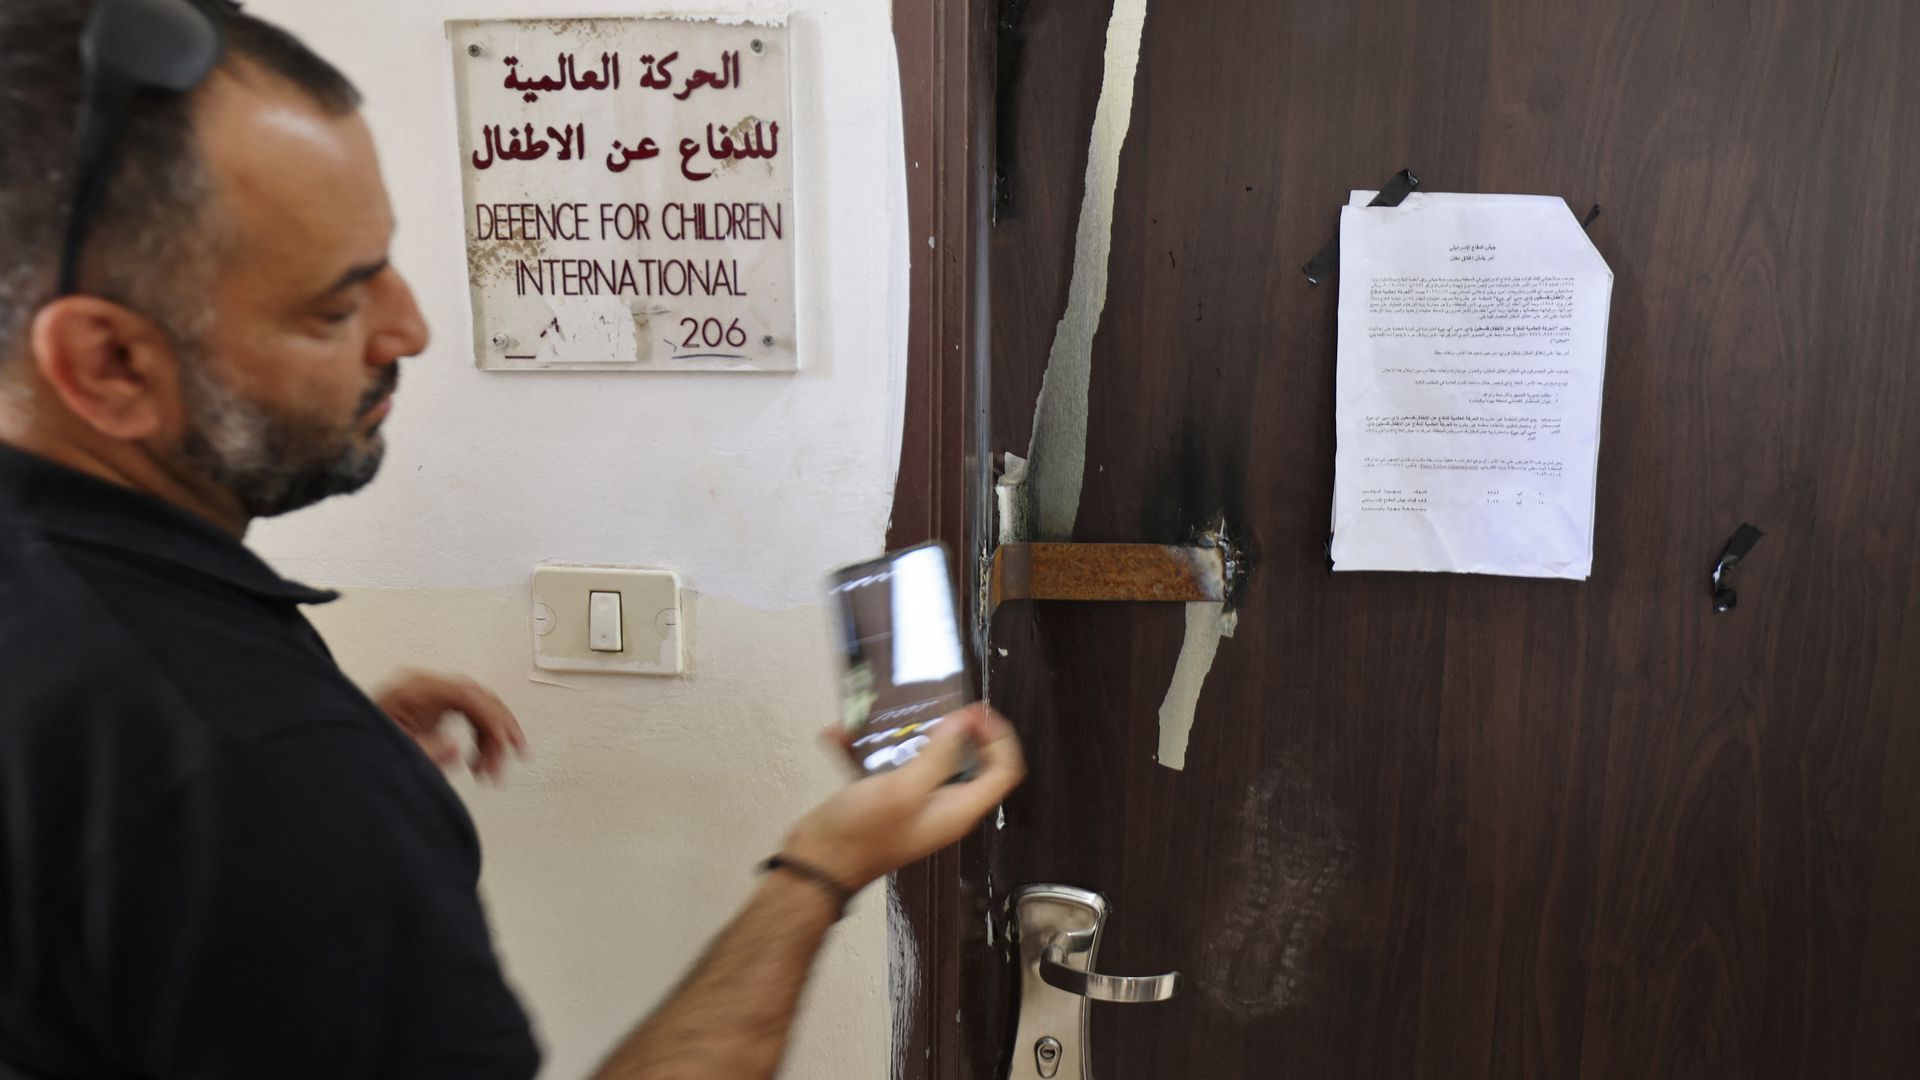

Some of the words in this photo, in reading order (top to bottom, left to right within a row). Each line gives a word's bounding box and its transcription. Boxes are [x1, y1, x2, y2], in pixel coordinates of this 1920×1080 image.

[503, 51, 620, 103] العالمية
[639, 50, 741, 101] الحركة
[606, 137, 660, 173] عن
[678, 121, 780, 181] للدفاع
[476, 203, 589, 241] DEFENCE
[600, 203, 651, 241] FOR
[662, 202, 783, 241] CHILDREN
[515, 259, 747, 297] INTERNATIONAL
[680, 317, 747, 348] 206
